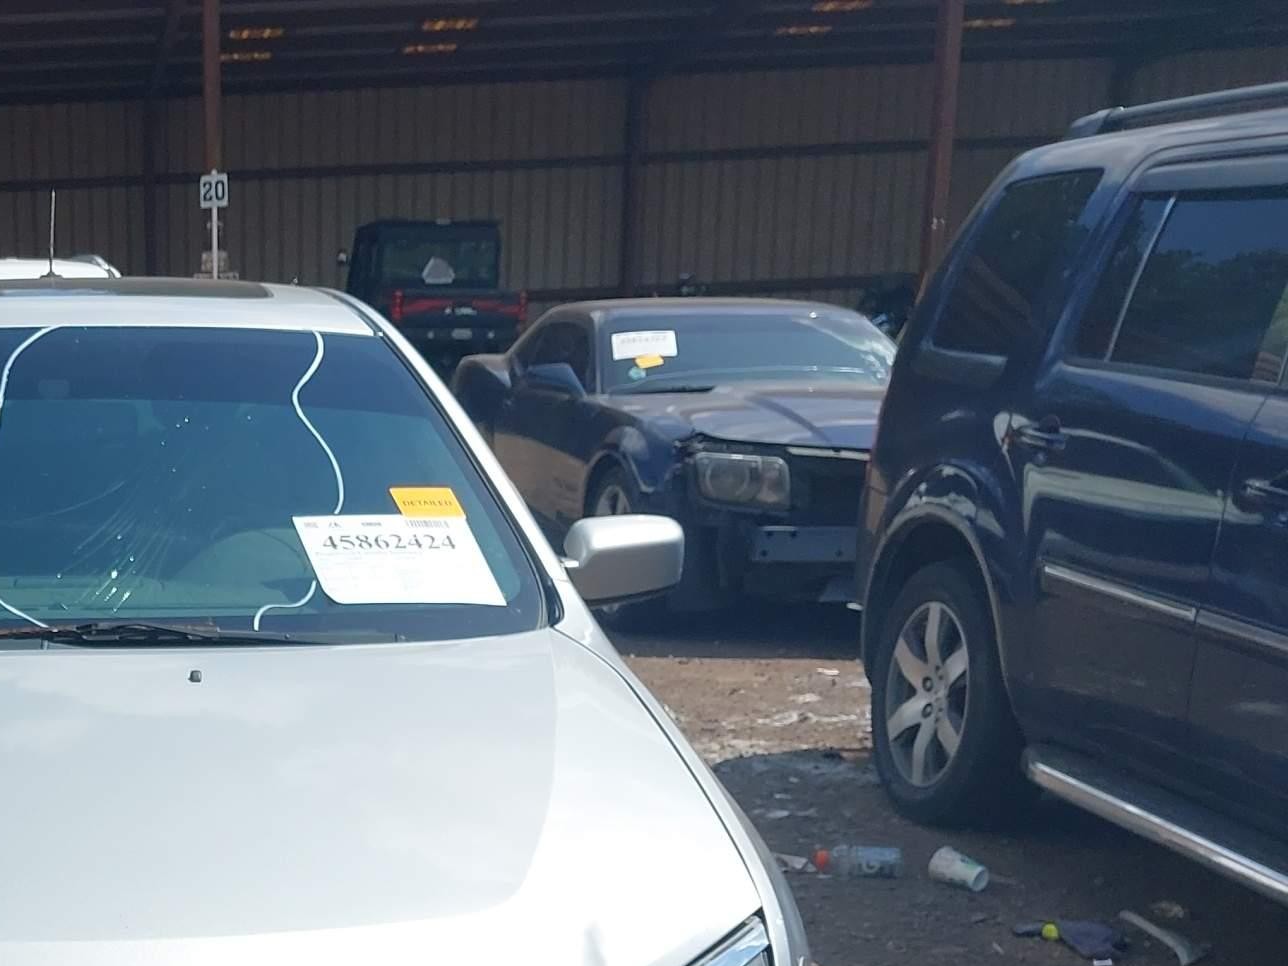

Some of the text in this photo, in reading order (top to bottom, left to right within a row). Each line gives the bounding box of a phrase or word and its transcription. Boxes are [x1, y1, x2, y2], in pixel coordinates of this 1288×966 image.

[202, 180, 225, 202] 20
[402, 498, 453, 507] DETAILED
[322, 533, 456, 550] 45862424
